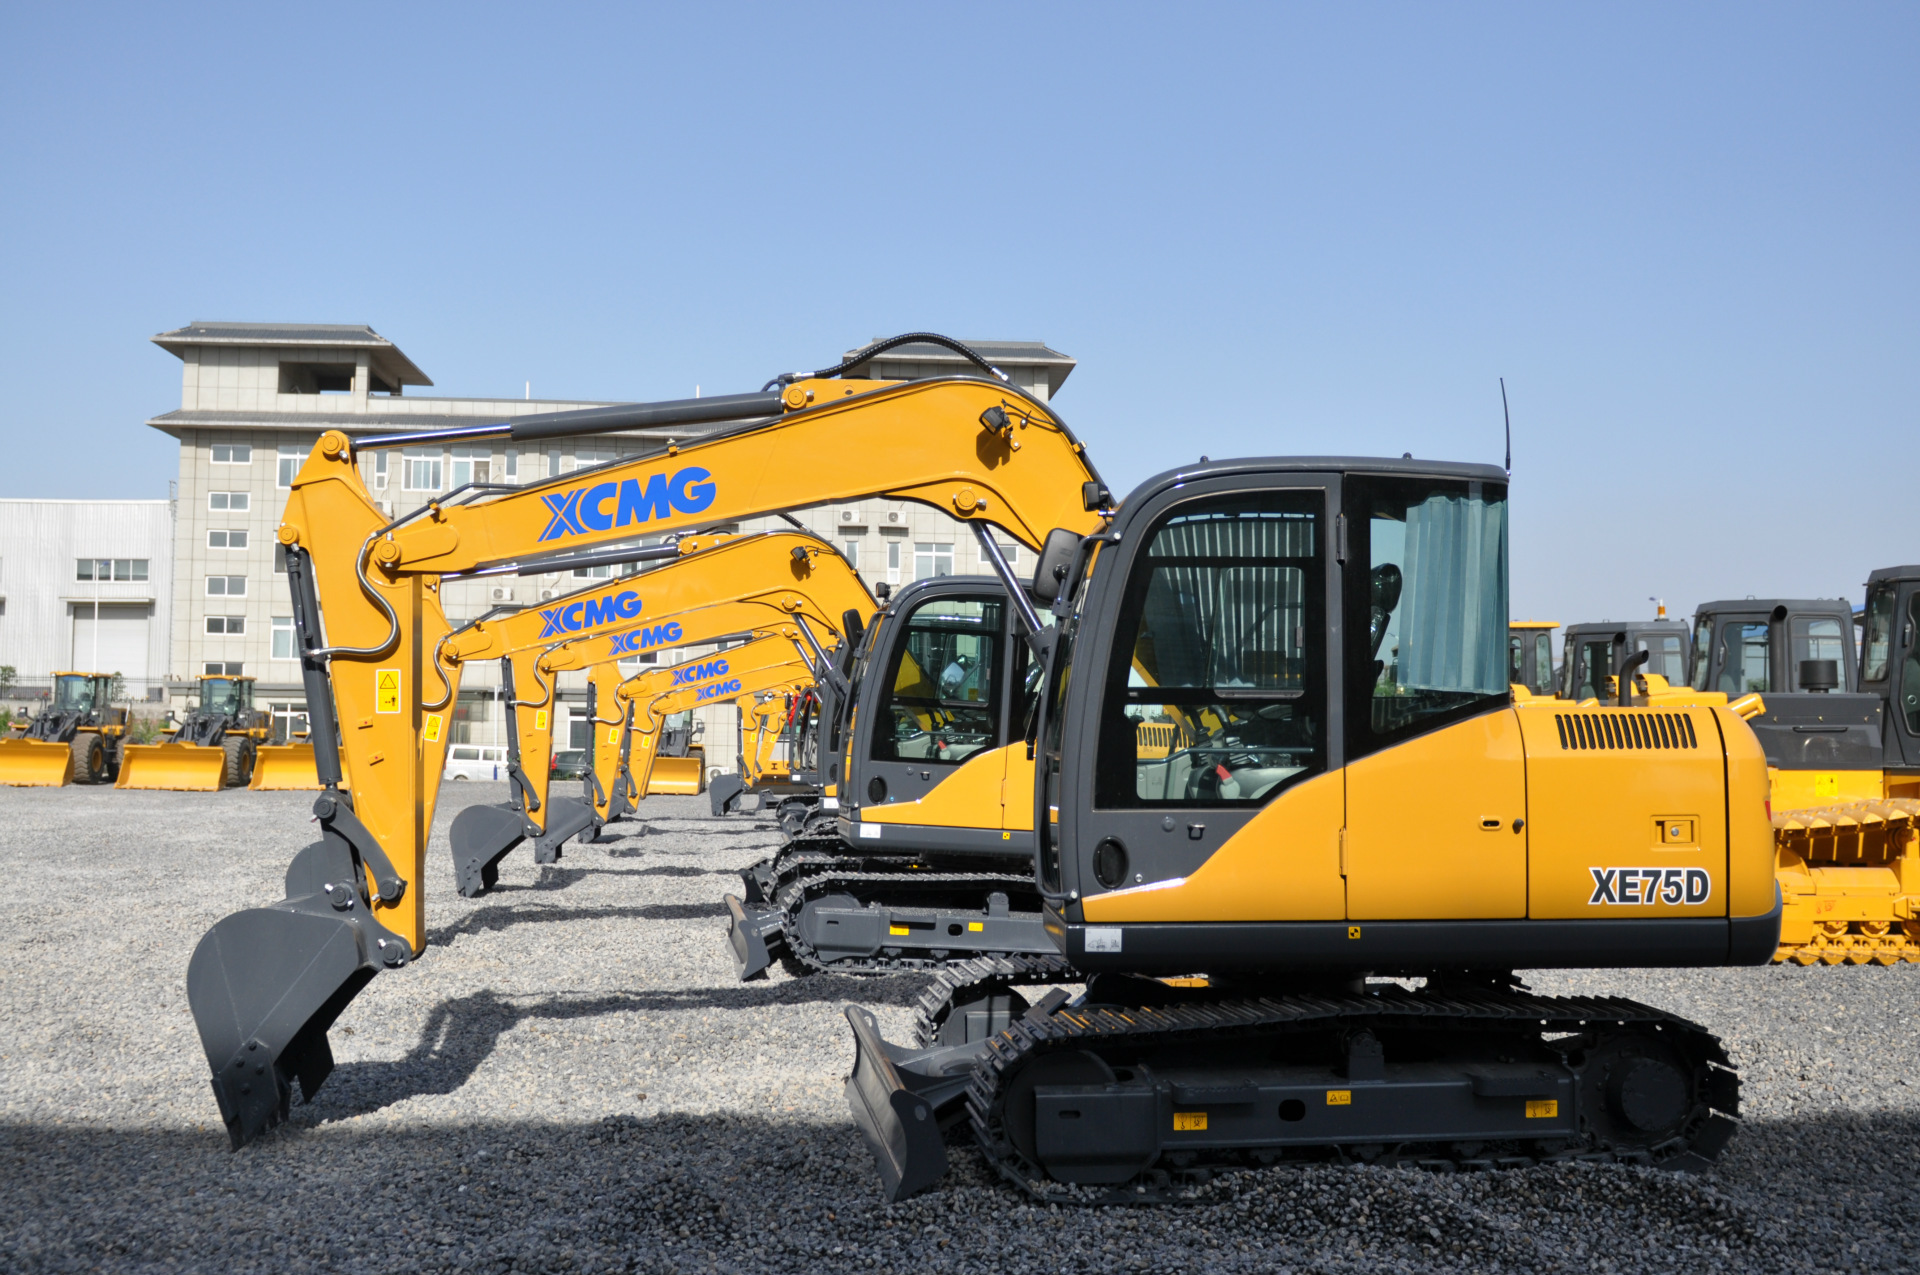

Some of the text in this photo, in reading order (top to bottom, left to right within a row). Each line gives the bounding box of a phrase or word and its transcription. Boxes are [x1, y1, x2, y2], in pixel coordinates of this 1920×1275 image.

[537, 466, 717, 542] XCMG
[538, 590, 643, 639] XCMG
[608, 621, 683, 656] XCMG
[670, 659, 730, 686] XCMG
[694, 678, 742, 702] XCMG
[1588, 867, 1711, 905] XE75D
